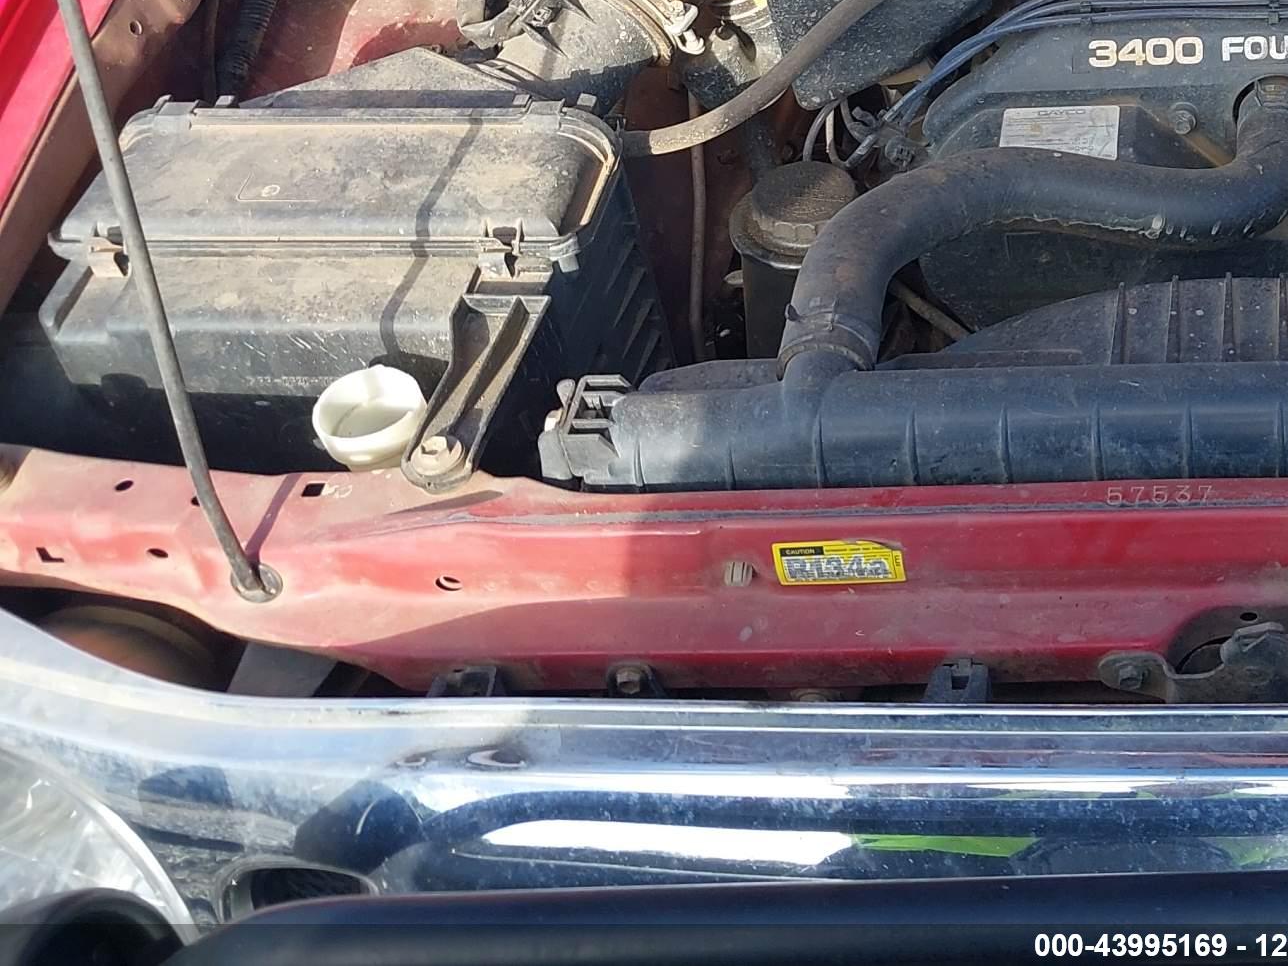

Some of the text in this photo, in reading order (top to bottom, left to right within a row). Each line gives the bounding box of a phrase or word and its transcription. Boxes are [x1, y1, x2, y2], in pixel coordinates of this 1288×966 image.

[1089, 36, 1203, 67] 3400
[1106, 485, 1212, 506] 57537
[786, 555, 892, 579] R134a
